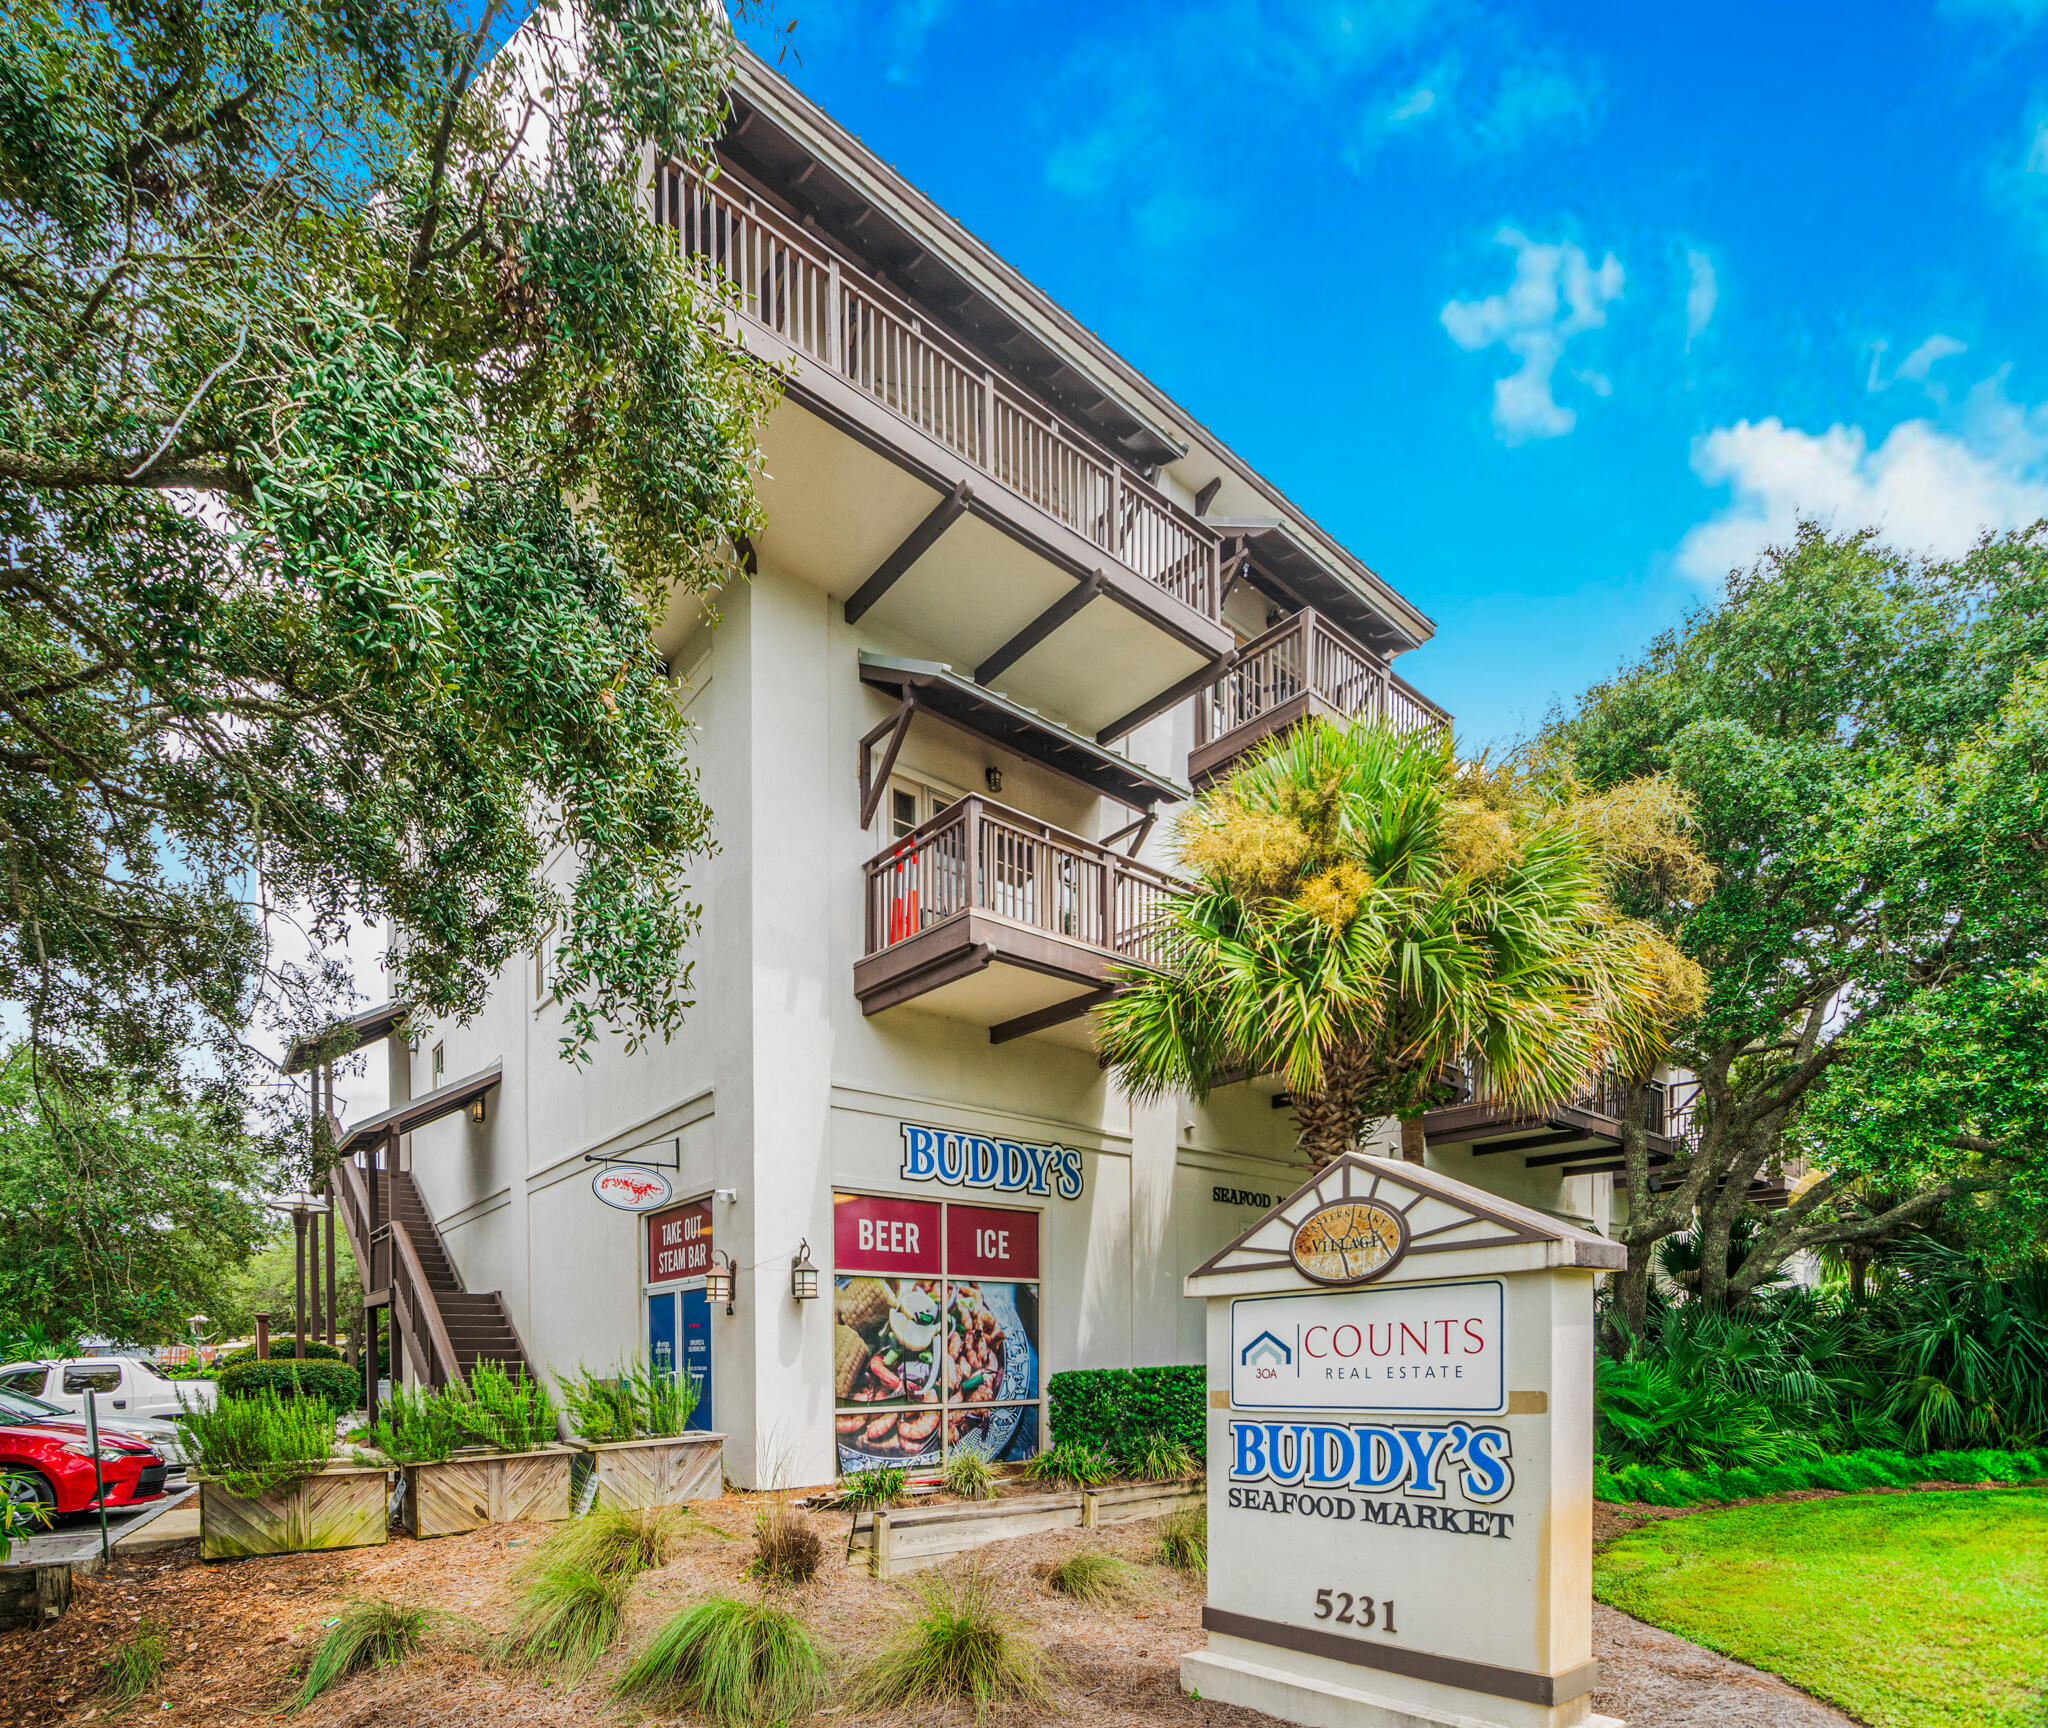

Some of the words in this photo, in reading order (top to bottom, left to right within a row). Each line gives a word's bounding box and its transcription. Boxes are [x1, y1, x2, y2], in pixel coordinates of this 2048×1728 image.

[900, 1122, 1084, 1200] BUDDY'S
[1212, 1186, 1271, 1208] SEAFOOD
[662, 1220, 682, 1247] TAKE
[684, 1216, 702, 1241] OUT
[858, 1218, 920, 1254] BEER
[976, 1228, 1010, 1259] ICE
[658, 1247, 686, 1274] STEAM
[688, 1243, 707, 1269] BAR
[1304, 1318, 1485, 1359] COUNTS
[1325, 1367, 1373, 1380] REAL
[1386, 1365, 1463, 1379] ESTATE
[1229, 1419, 1515, 1505] BUDDY'S
[1228, 1487, 1356, 1521] SEAFOOD
[1360, 1498, 1514, 1540] MARKET
[1313, 1588, 1398, 1633] 5231
